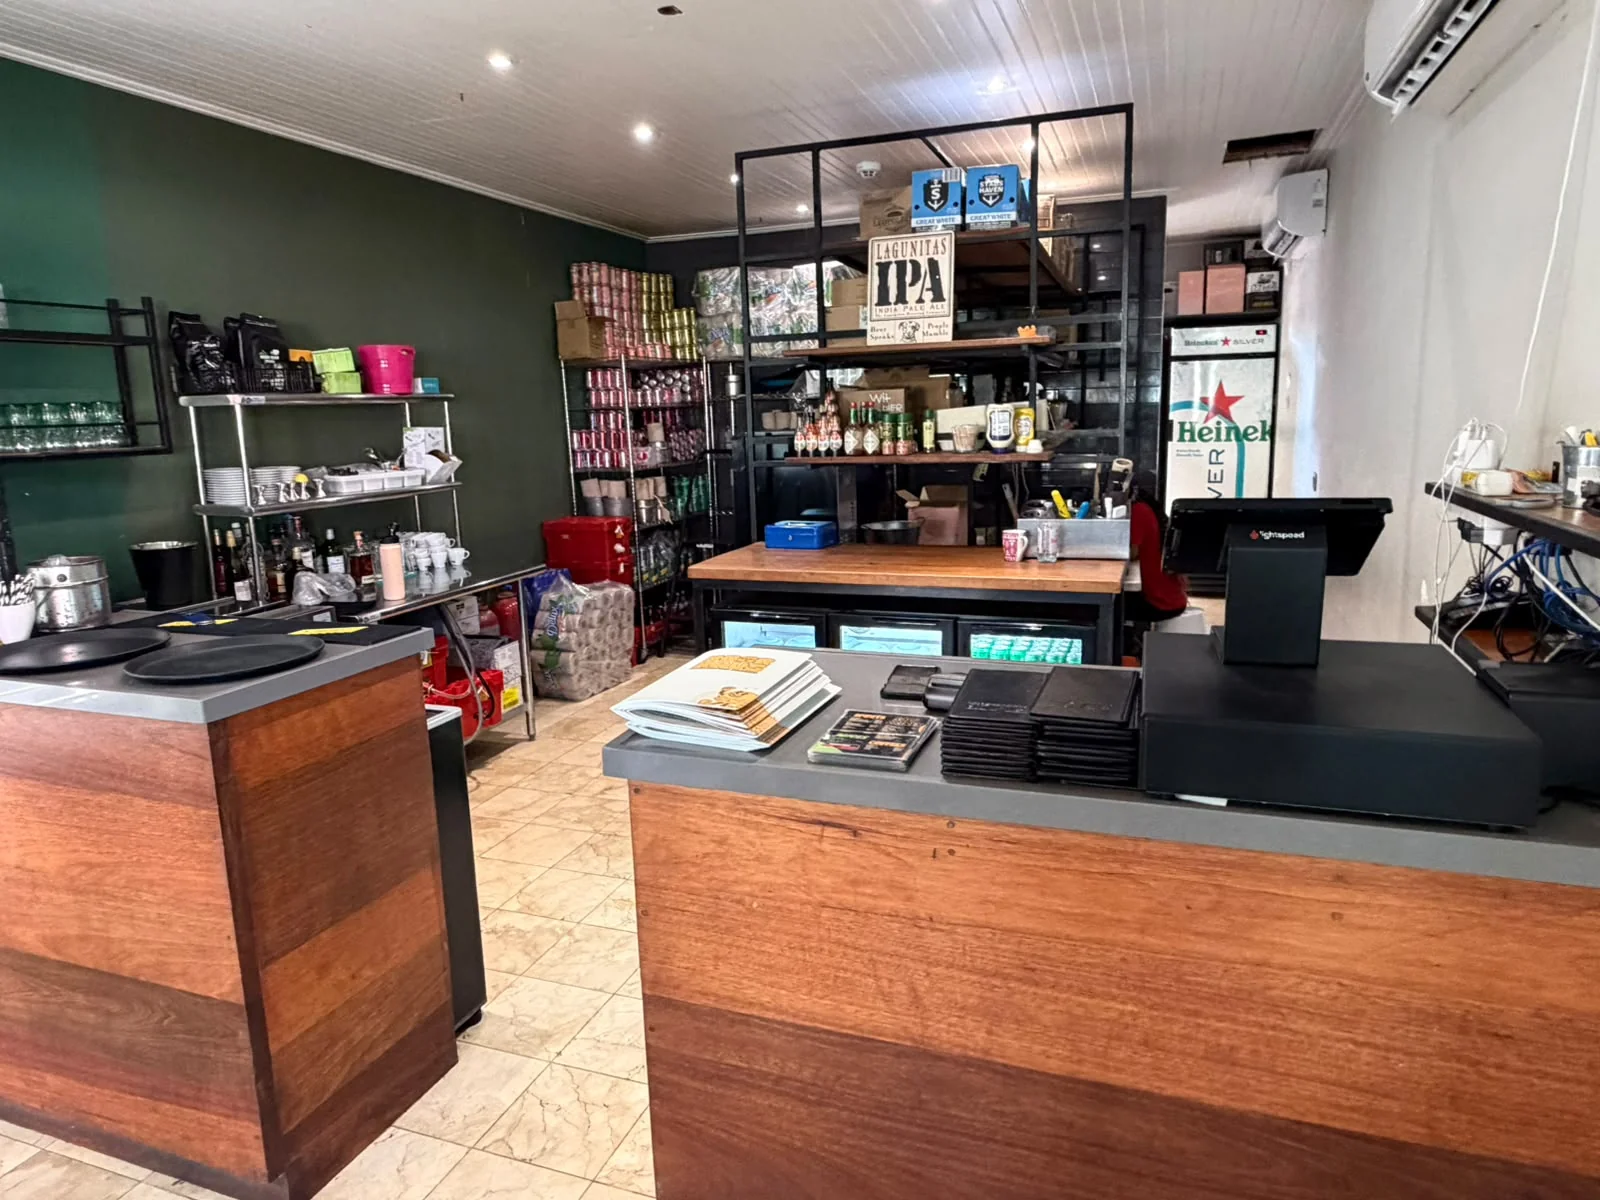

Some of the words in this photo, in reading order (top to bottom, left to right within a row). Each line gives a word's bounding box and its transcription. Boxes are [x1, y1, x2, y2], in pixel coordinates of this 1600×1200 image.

[930, 188, 941, 200] S
[876, 238, 947, 260] LAGUNITAS
[875, 257, 946, 306] IPA
[1176, 420, 1271, 443] Heinek
